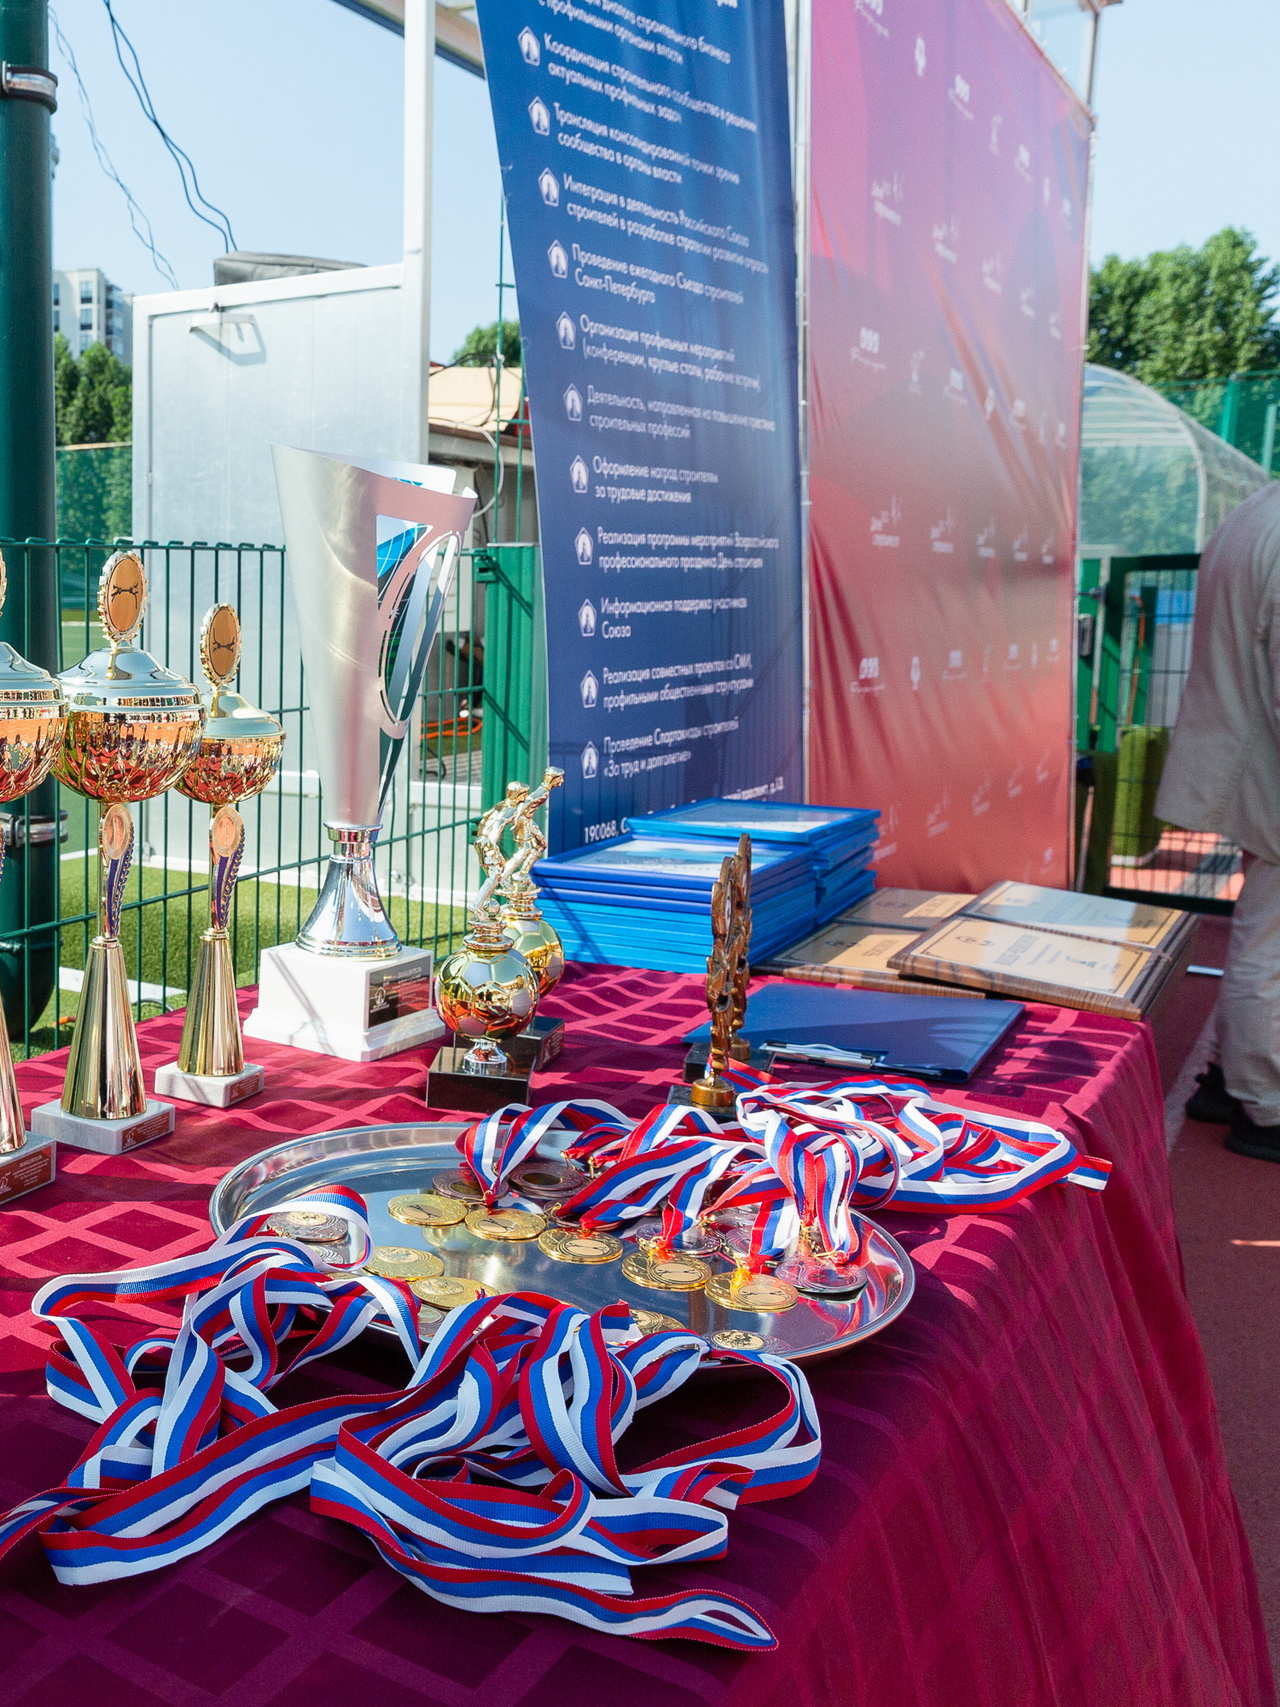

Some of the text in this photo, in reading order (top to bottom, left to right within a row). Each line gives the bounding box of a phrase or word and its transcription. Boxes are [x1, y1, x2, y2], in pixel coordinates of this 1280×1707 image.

[544, 33, 610, 72] Координация
[548, 62, 603, 92] актуальных
[553, 102, 608, 136] Трансляция
[558, 133, 615, 161] сообщества
[563, 173, 618, 205] Интеграция
[567, 203, 619, 227] строителей
[572, 243, 628, 274] Проведение
[575, 268, 655, 304] Санкт-Петербурга
[580, 314, 639, 342] Организация
[587, 385, 646, 412] Деятельность,
[589, 415, 646, 432] строительных
[593, 455, 649, 479] Оформление
[595, 486, 691, 503] за трудовые достижения
[598, 526, 648, 546] Реализация
[599, 552, 680, 572] профессионального
[601, 598, 674, 618] Информационная
[602, 621, 631, 638] Союза
[603, 667, 650, 684] Реализация
[604, 690, 660, 712] профильными
[604, 735, 653, 755] Проведение
[604, 759, 620, 777] «За
[621, 760, 640, 778] труд
[584, 820, 619, 843] 190068,
